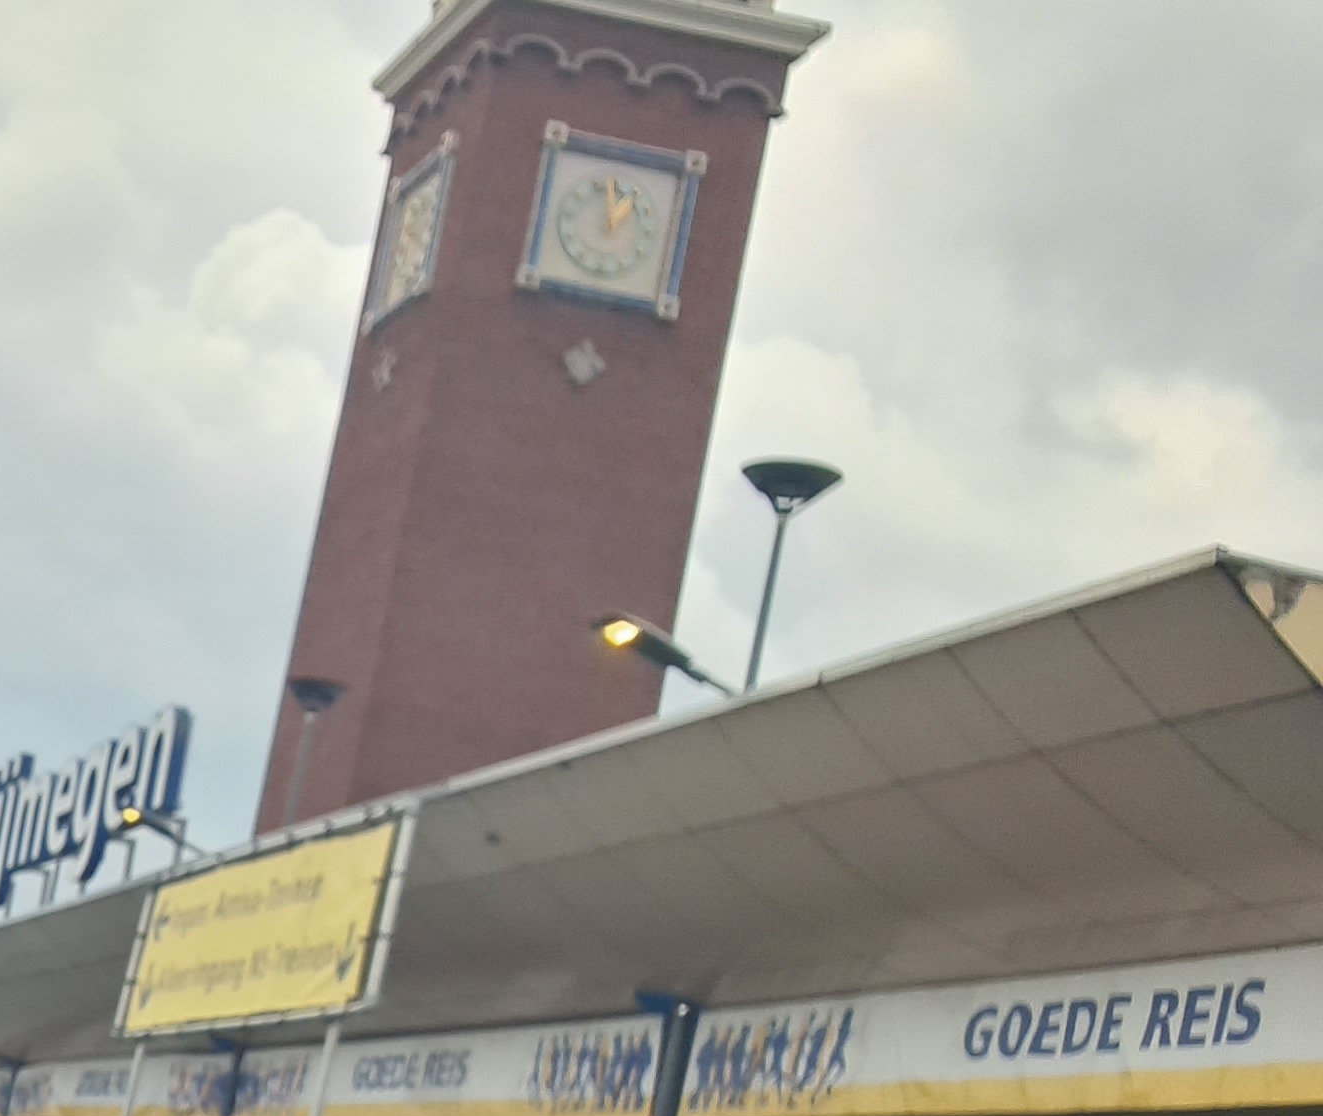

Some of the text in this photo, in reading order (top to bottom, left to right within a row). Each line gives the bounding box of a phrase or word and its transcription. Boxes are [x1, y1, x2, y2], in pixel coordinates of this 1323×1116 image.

[964, 979, 1266, 1060] GOEDE REIS
[353, 1049, 471, 1091] GOEDE REIS
